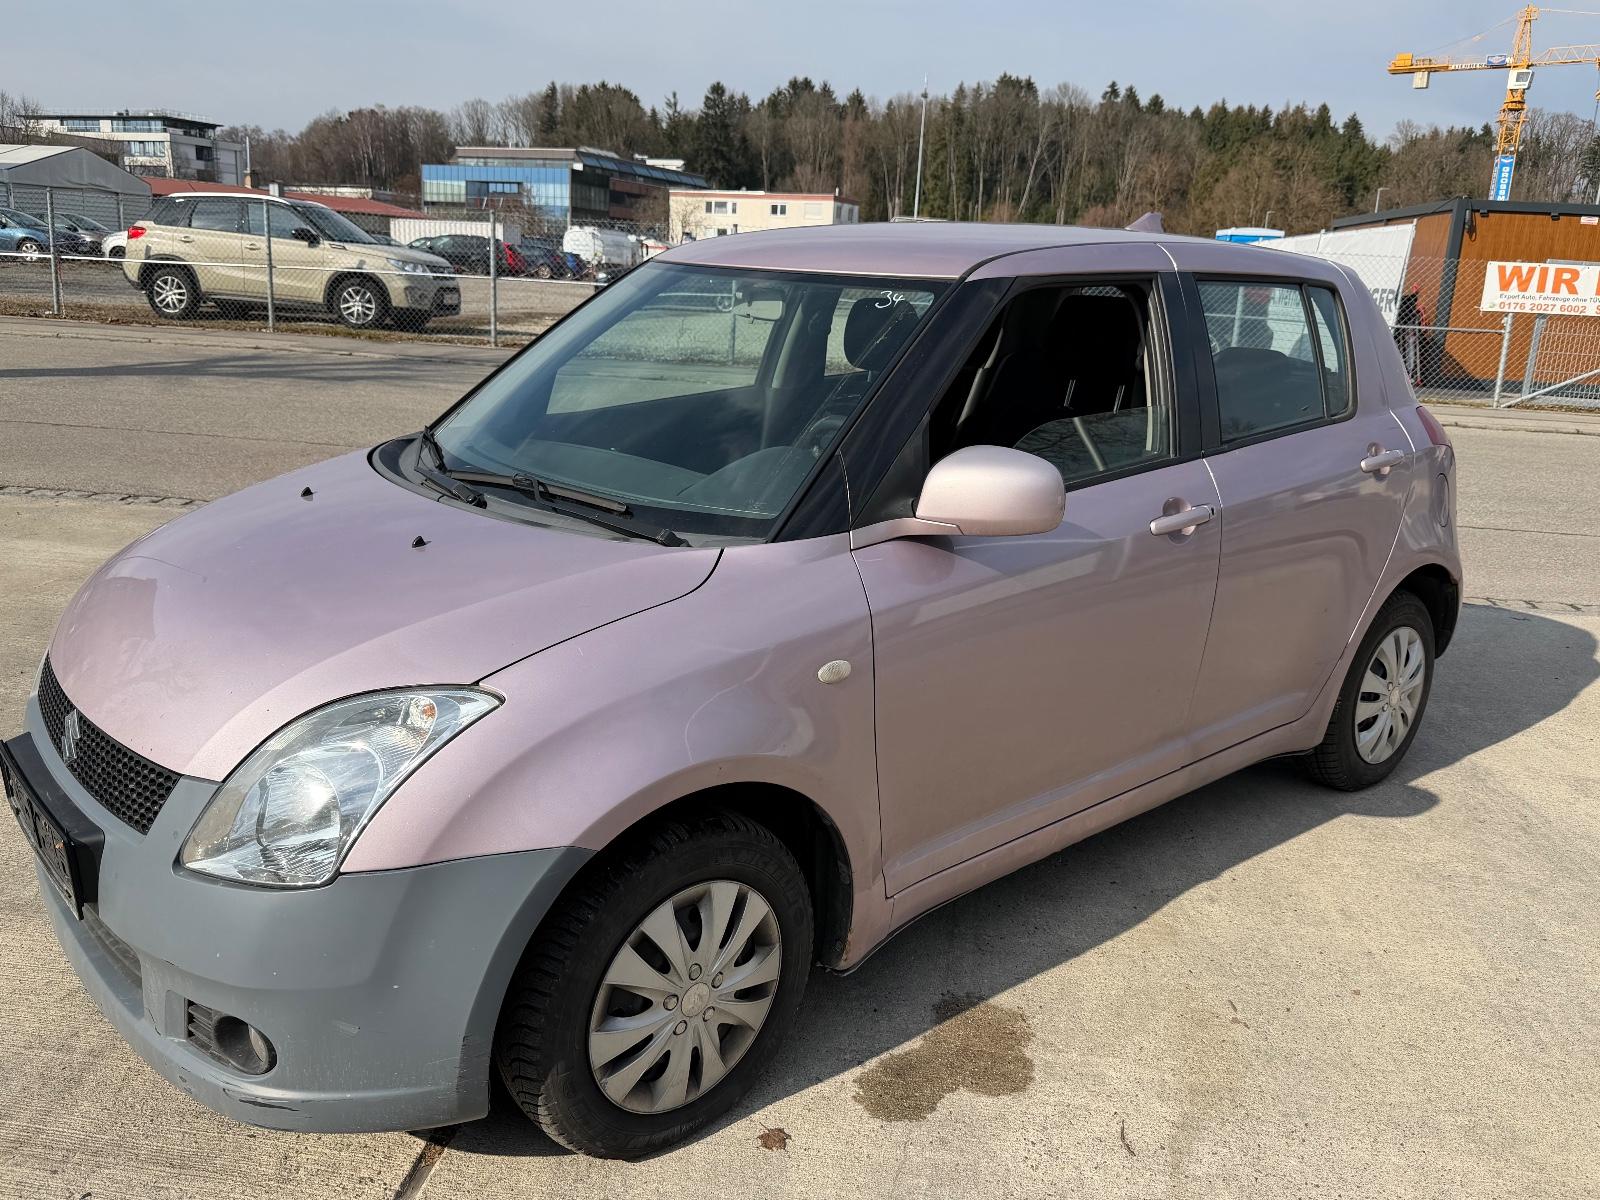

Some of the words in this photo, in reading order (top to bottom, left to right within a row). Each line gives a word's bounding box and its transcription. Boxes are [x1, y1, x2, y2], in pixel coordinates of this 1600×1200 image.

[1498, 265, 1580, 295] WIR
[874, 290, 905, 308] 34
[1369, 287, 1396, 312] GER
[1499, 301, 1526, 310] 0176
[1529, 303, 1557, 312] 2027
[1560, 304, 1587, 314] 6002
[1538, 295, 1570, 303] Fahrzeuge
